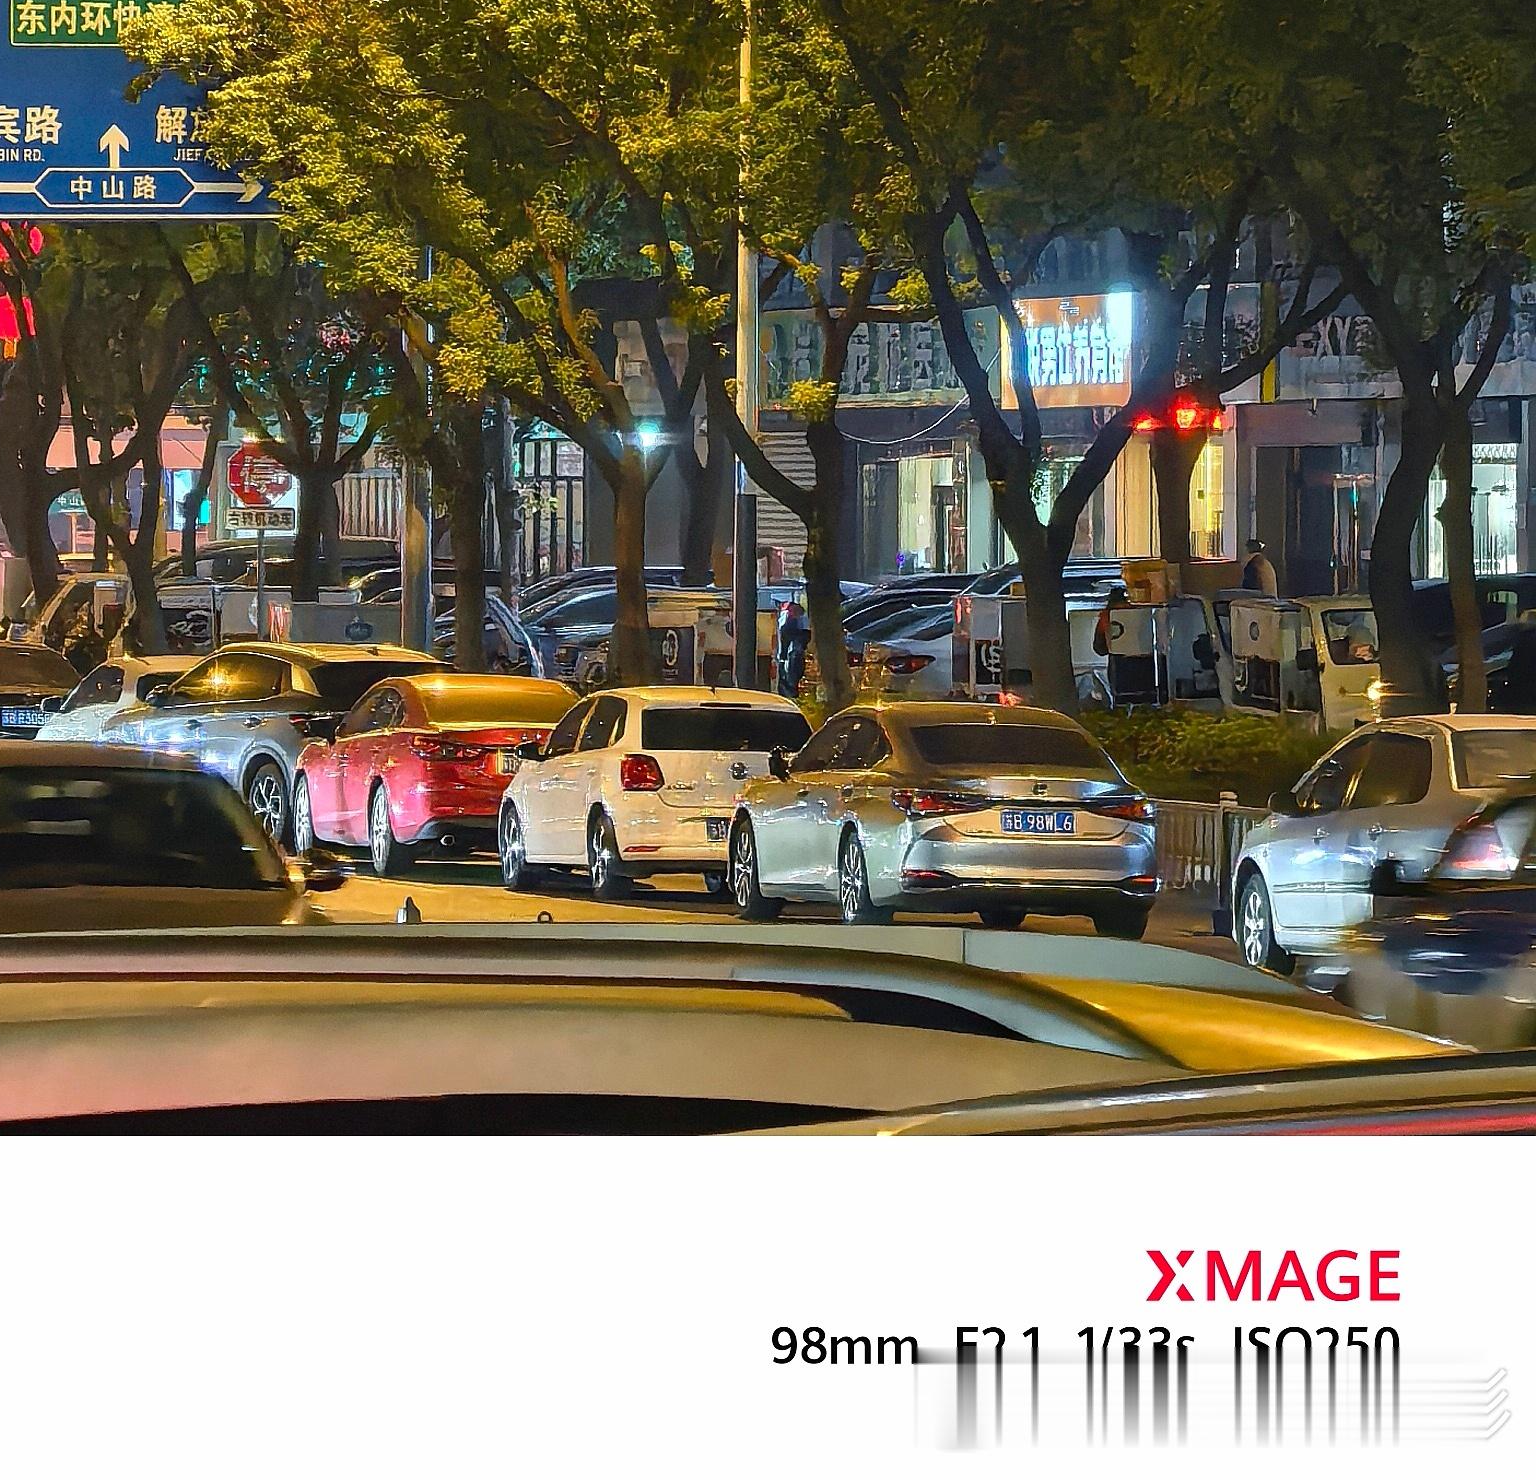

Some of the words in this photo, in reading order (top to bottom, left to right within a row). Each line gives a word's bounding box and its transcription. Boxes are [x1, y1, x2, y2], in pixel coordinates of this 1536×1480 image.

[23, 148, 46, 162] RD.
[173, 148, 207, 161] JIEF
[70, 175, 157, 201] 中山路
